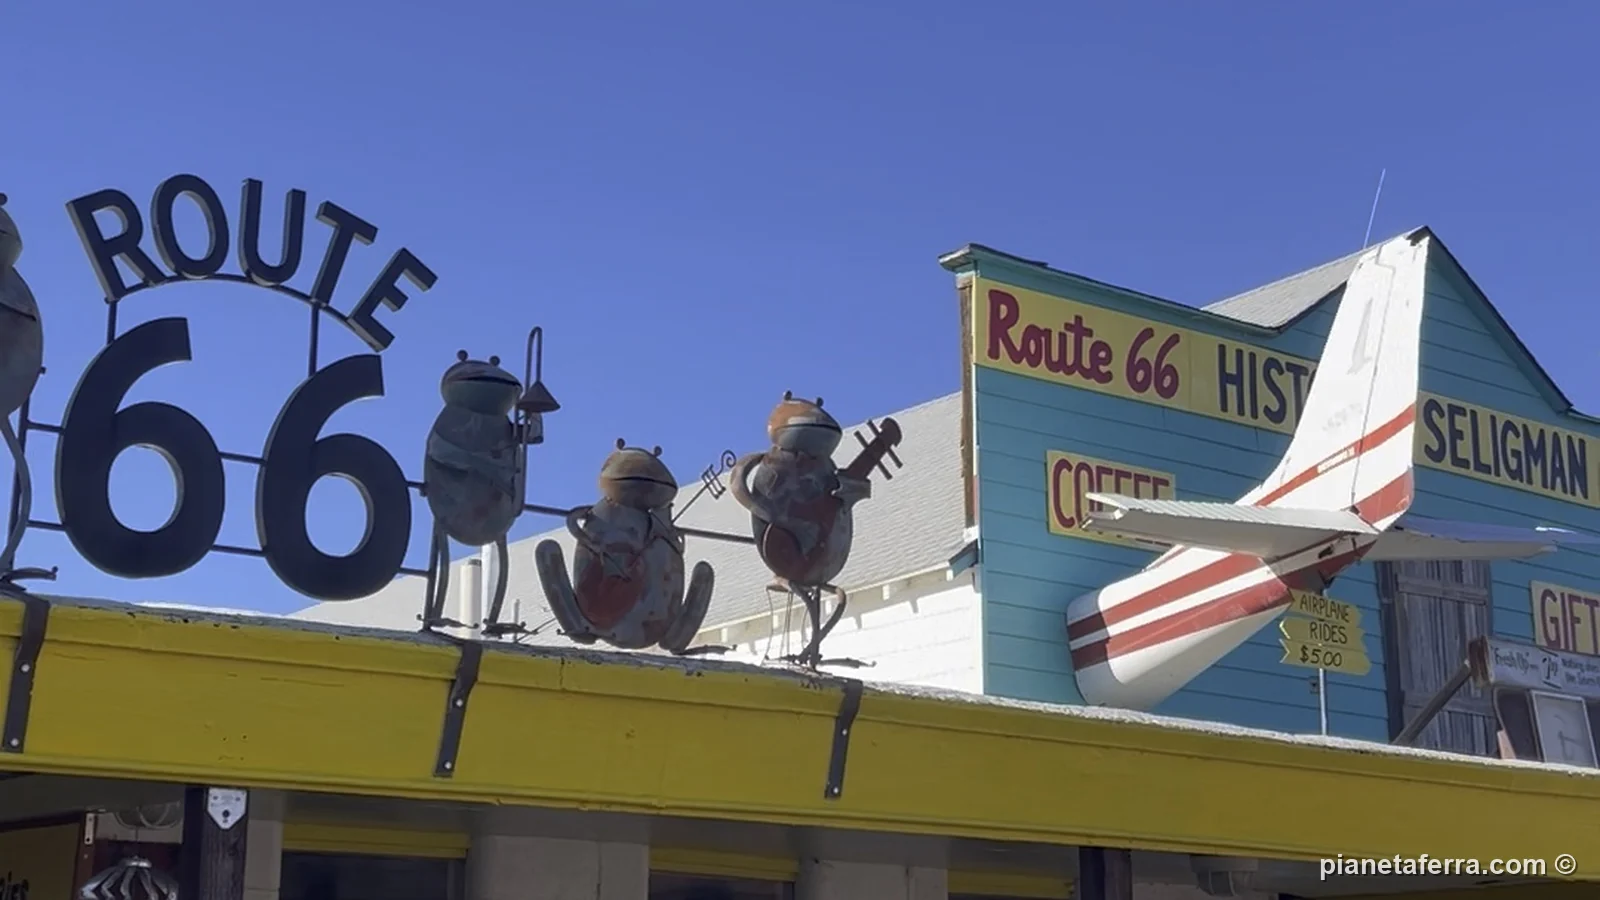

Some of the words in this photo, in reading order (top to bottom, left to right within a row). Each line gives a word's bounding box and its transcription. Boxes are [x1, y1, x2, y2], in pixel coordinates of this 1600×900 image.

[65, 173, 438, 352] ROUTE
[54, 316, 412, 601] 66
[987, 288, 1114, 385] Route
[1125, 326, 1181, 400] 66
[1217, 343, 1317, 429] HIST
[1423, 398, 1589, 500] SELIGMAN
[1300, 594, 1350, 623] AIRPLANE
[1309, 621, 1348, 645] RIDES
